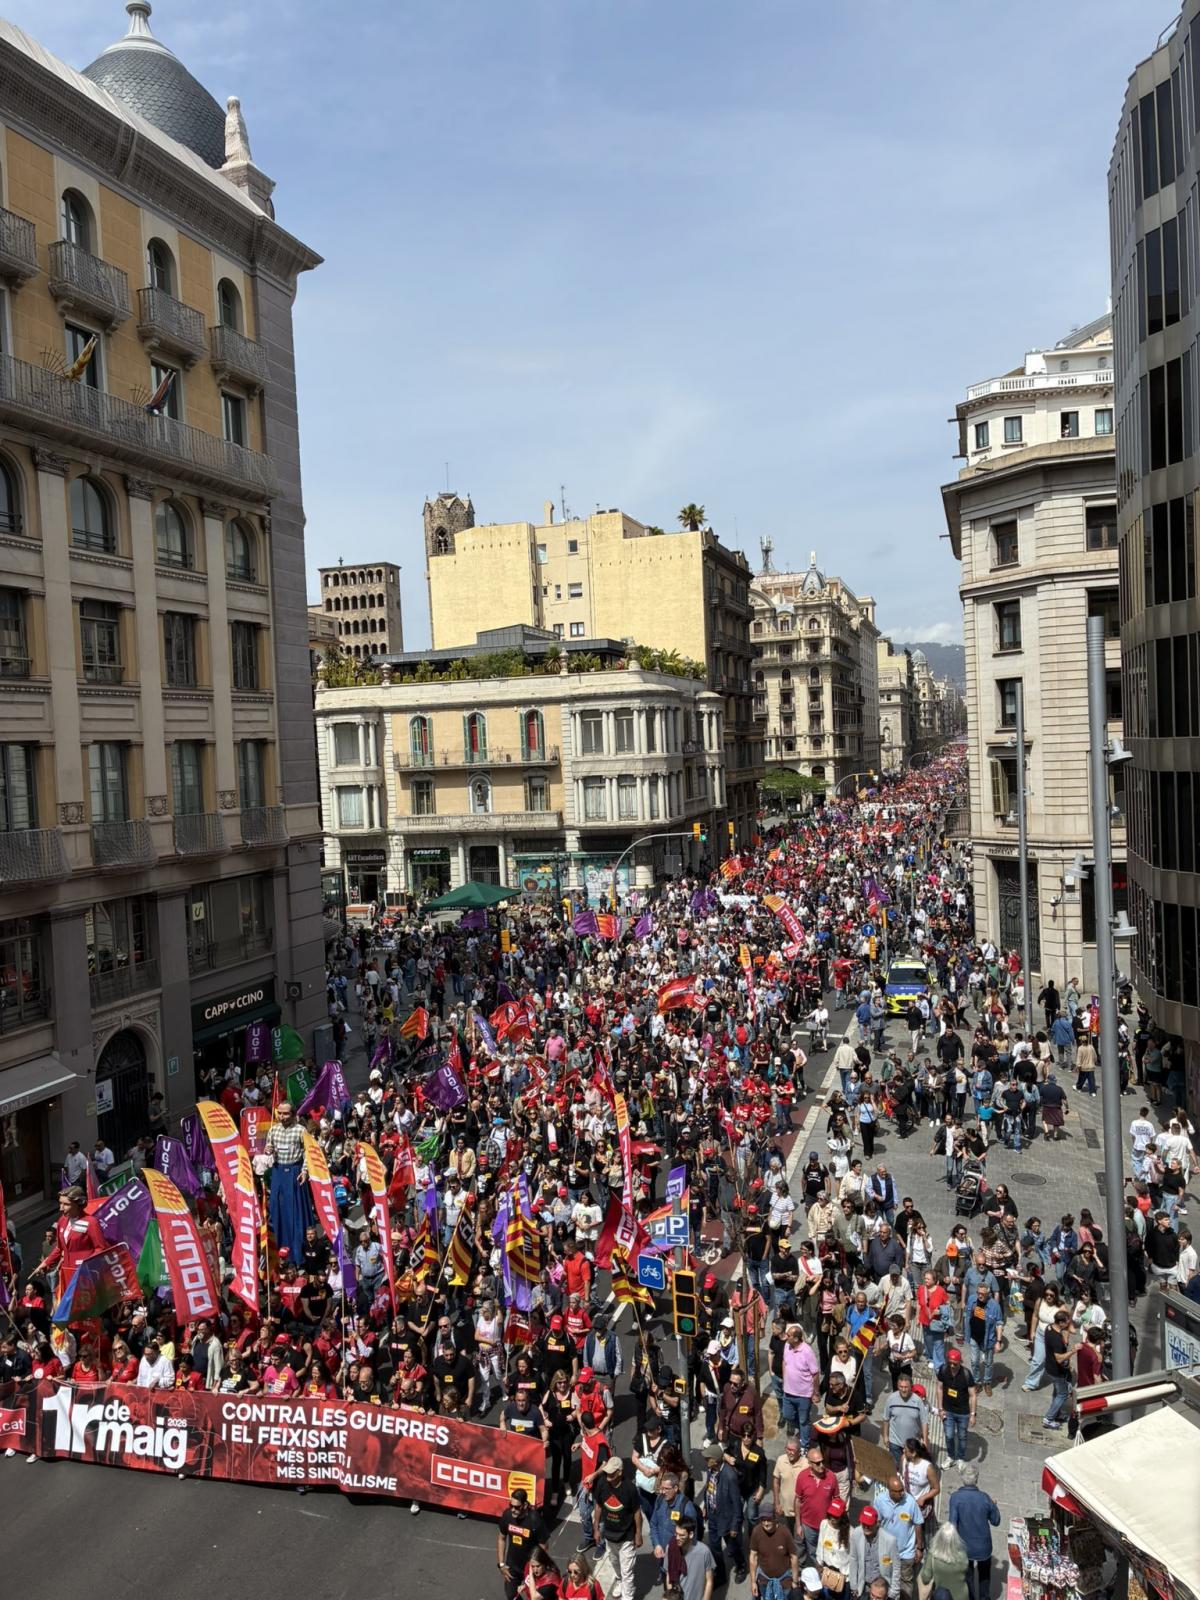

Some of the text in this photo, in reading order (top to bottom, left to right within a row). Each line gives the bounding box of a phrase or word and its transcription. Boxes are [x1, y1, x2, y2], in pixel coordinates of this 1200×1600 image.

[204, 989, 264, 1020] CAPPCCINO
[252, 1027, 261, 1056] UGT
[247, 1112, 257, 1147] UGT
[161, 1140, 172, 1178] UGT
[104, 1185, 143, 1222] UGT
[669, 1216, 685, 1235] P
[104, 1399, 131, 1421] de
[222, 1402, 450, 1446] CONTRA LES GUERRES
[95, 1416, 188, 1469] maig
[221, 1423, 348, 1449] I EL FEIXISME
[277, 1449, 304, 1463] MÉS
[277, 1466, 398, 1491] MÉS SINDCALISME
[436, 1462, 502, 1491] CCOO
